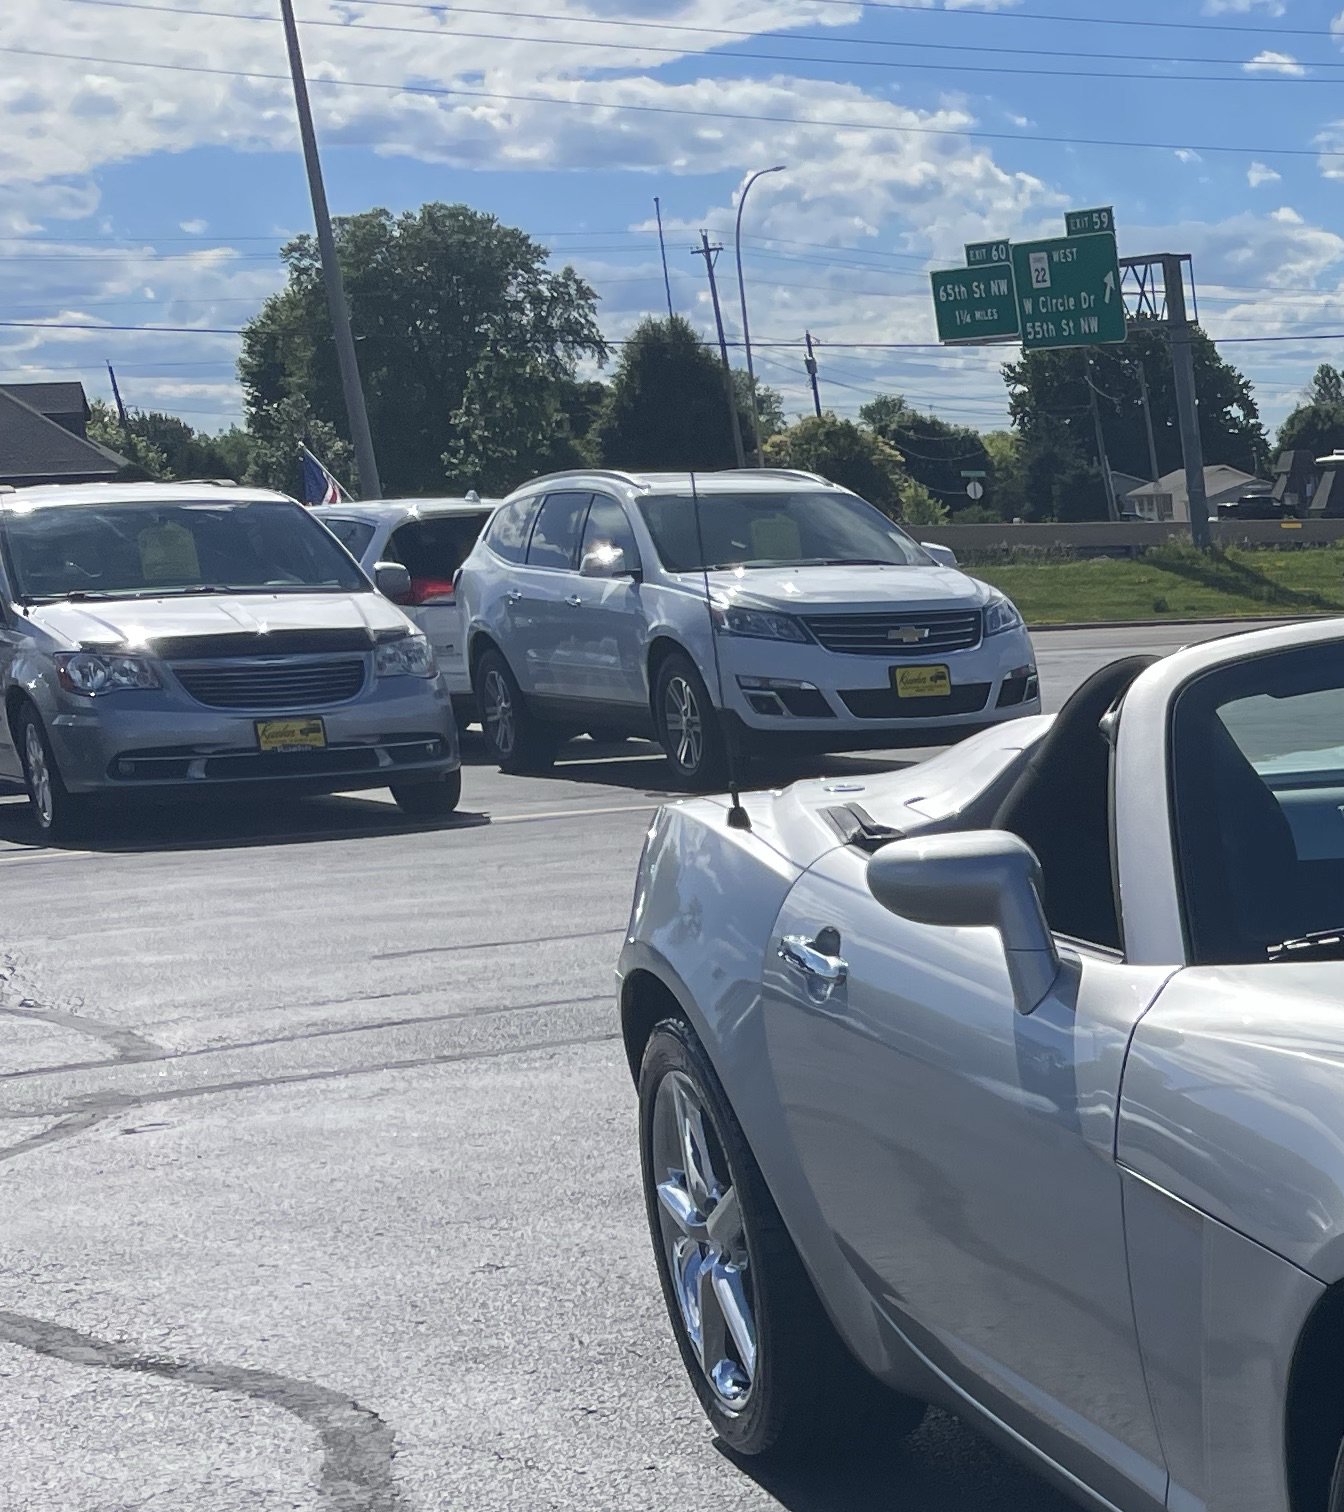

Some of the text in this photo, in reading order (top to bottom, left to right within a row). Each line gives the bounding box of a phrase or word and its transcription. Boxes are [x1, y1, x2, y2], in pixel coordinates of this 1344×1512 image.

[1070, 212, 1108, 230] EXIT 59
[969, 245, 1006, 260] EXIT 60
[1052, 248, 1077, 262] WEST
[1034, 268, 1047, 283] 22
[940, 279, 1008, 301] 65th St NW
[1023, 292, 1095, 314] W Circle Dr
[975, 309, 998, 320] MILES
[1026, 317, 1098, 339] 55th St NW
